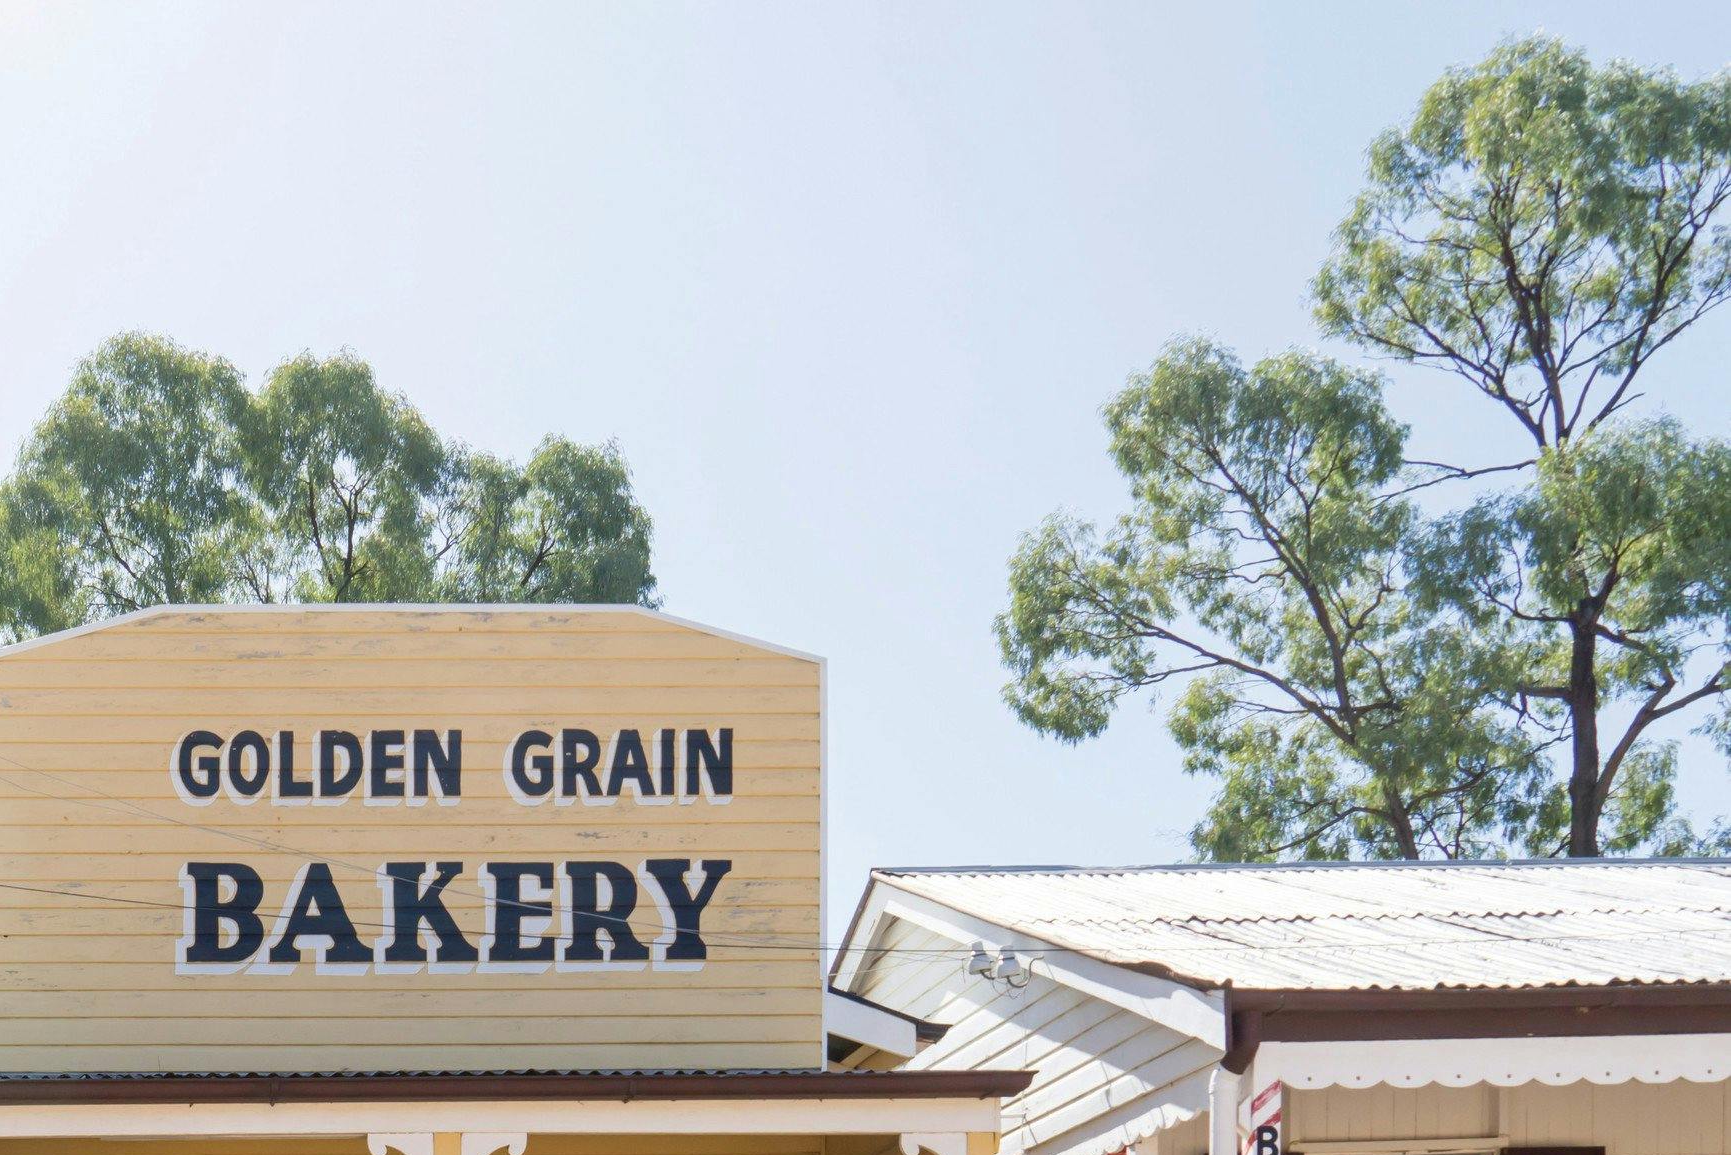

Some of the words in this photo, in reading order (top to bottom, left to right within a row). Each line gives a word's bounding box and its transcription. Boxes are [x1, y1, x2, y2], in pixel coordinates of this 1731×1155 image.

[170, 728, 463, 805] GOLDEN
[504, 728, 734, 805] GRAIN
[175, 859, 732, 975] BAKERY
